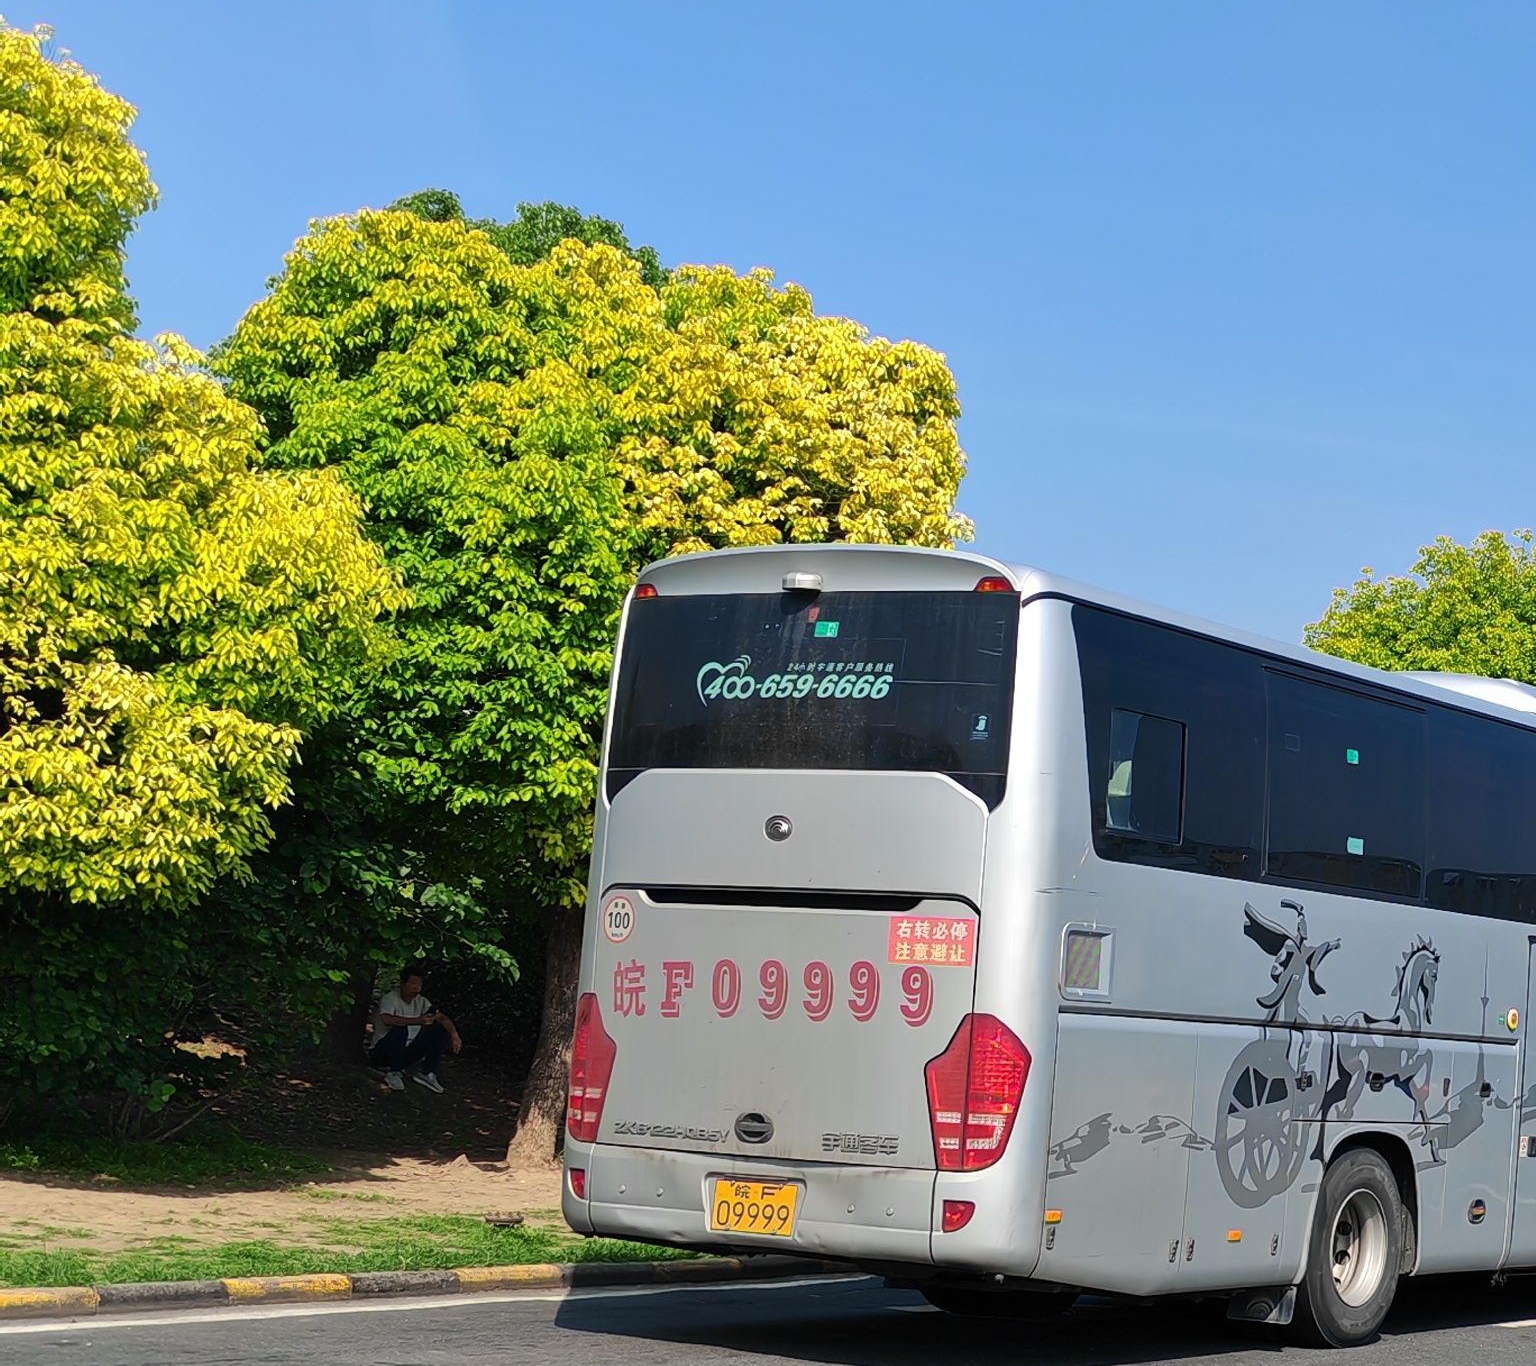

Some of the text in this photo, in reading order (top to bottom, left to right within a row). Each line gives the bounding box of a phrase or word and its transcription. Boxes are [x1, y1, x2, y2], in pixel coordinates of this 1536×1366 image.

[704, 673, 894, 699] 400-659-6666
[608, 911, 630, 930] 100
[896, 919, 969, 941] 右转必停
[895, 941, 967, 963] 注意避让
[821, 1132, 899, 1155] 宇通客车
[716, 1199, 790, 1231] 09999
